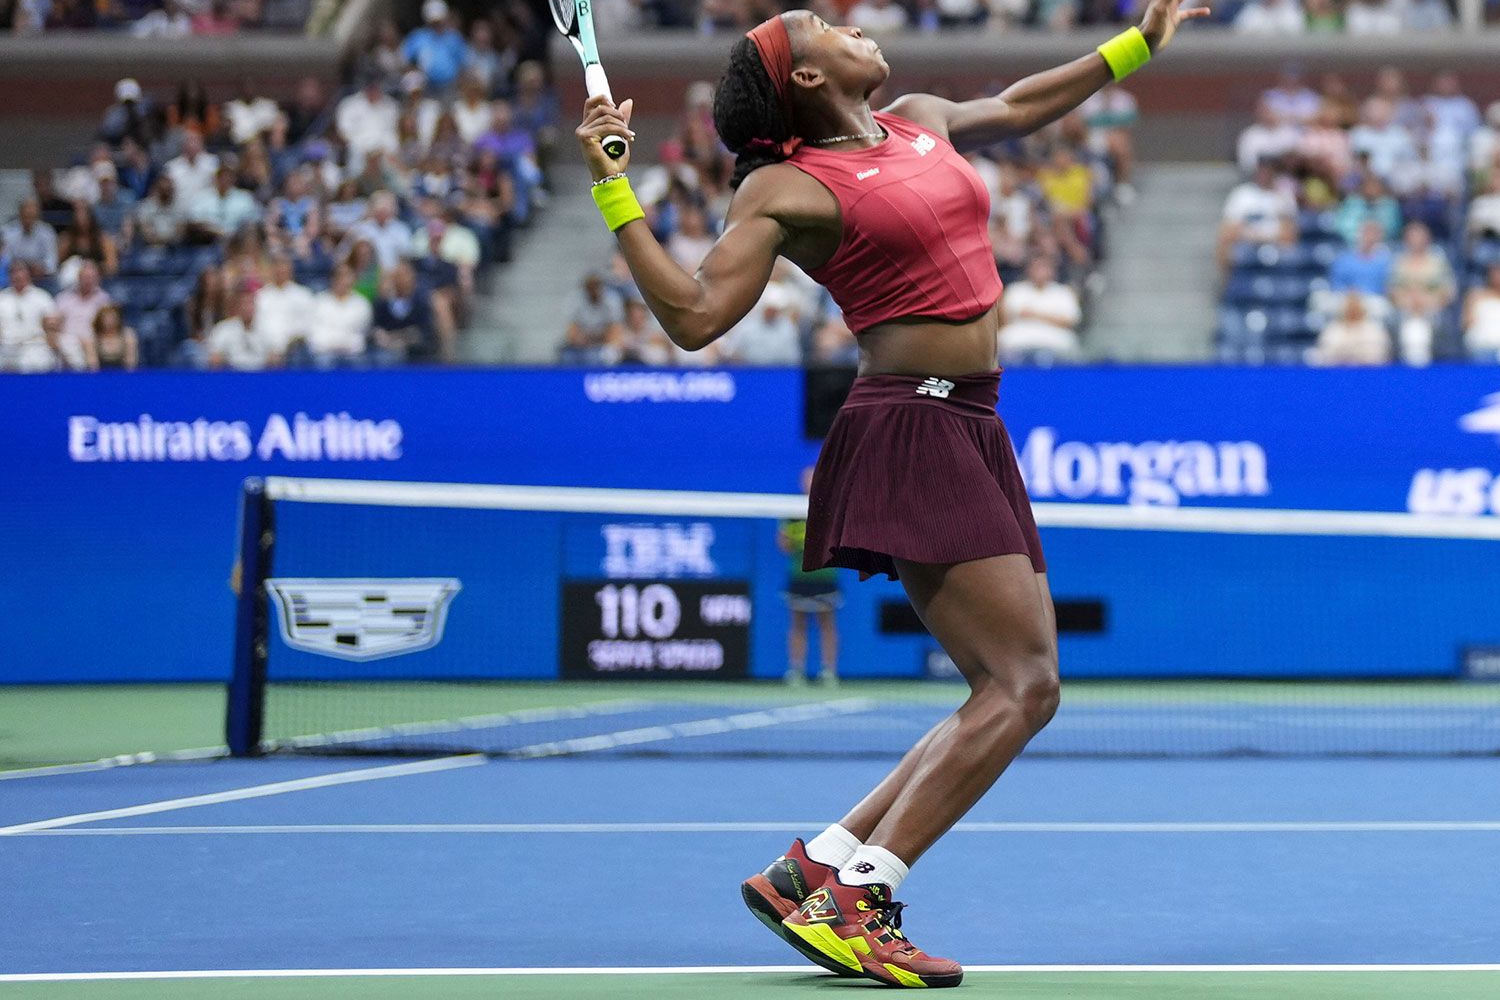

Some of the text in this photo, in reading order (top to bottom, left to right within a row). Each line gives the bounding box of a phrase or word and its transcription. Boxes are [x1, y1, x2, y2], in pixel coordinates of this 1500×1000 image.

[68, 412, 403, 462] Emirates Airline
[602, 522, 717, 578] IBM
[596, 583, 681, 639] 110
